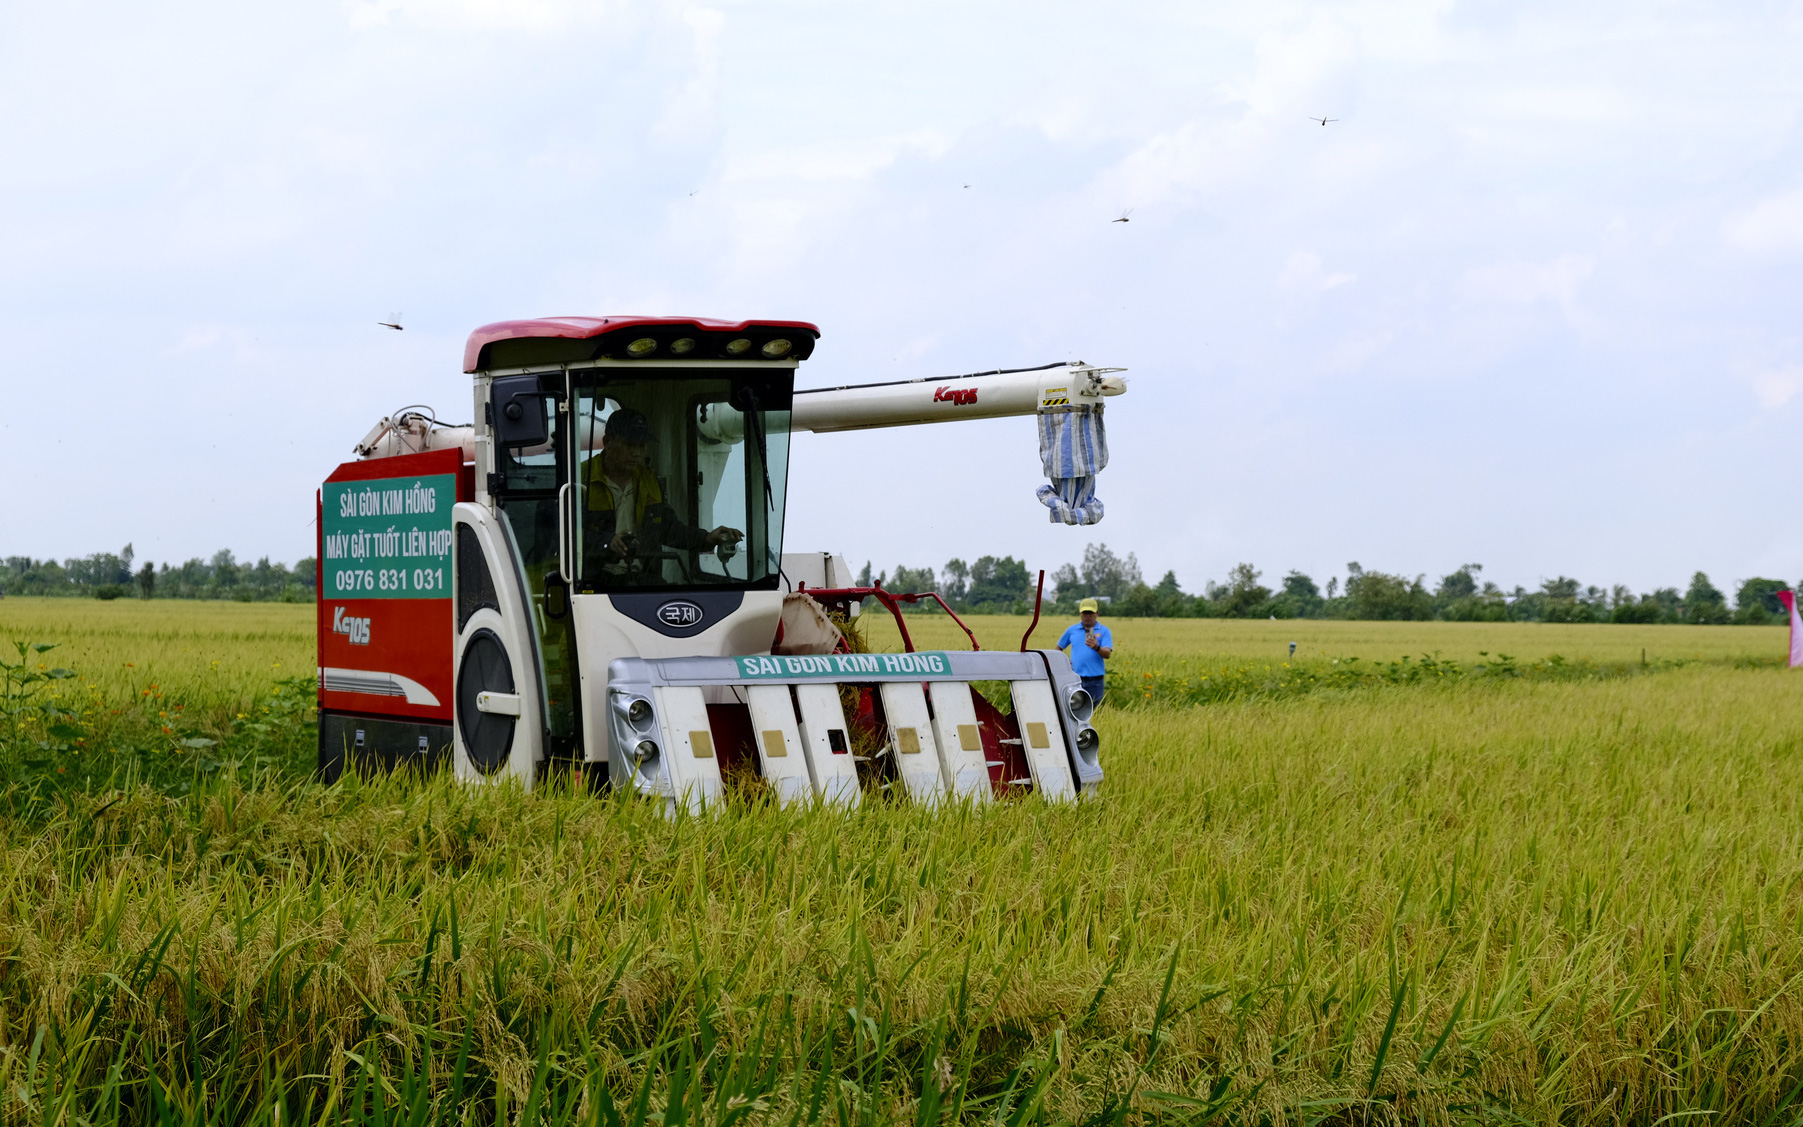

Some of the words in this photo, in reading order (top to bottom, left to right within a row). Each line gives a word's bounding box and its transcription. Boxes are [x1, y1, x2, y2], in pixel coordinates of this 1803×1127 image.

[340, 488, 357, 518] SÀI
[359, 487, 380, 516] GÒN
[382, 490, 402, 515] KIM
[406, 481, 436, 514] HỒNG
[326, 530, 349, 559] MÁY
[351, 529, 371, 562] GẶT
[373, 525, 400, 558] TUỐT
[402, 526, 426, 556] LIÊN
[430, 529, 452, 560] HỢP
[336, 570, 374, 590] 0976
[379, 569, 406, 590] 831
[414, 568, 442, 590] 031
[665, 606, 696, 624] 국제
[834, 656, 880, 672] KIM
